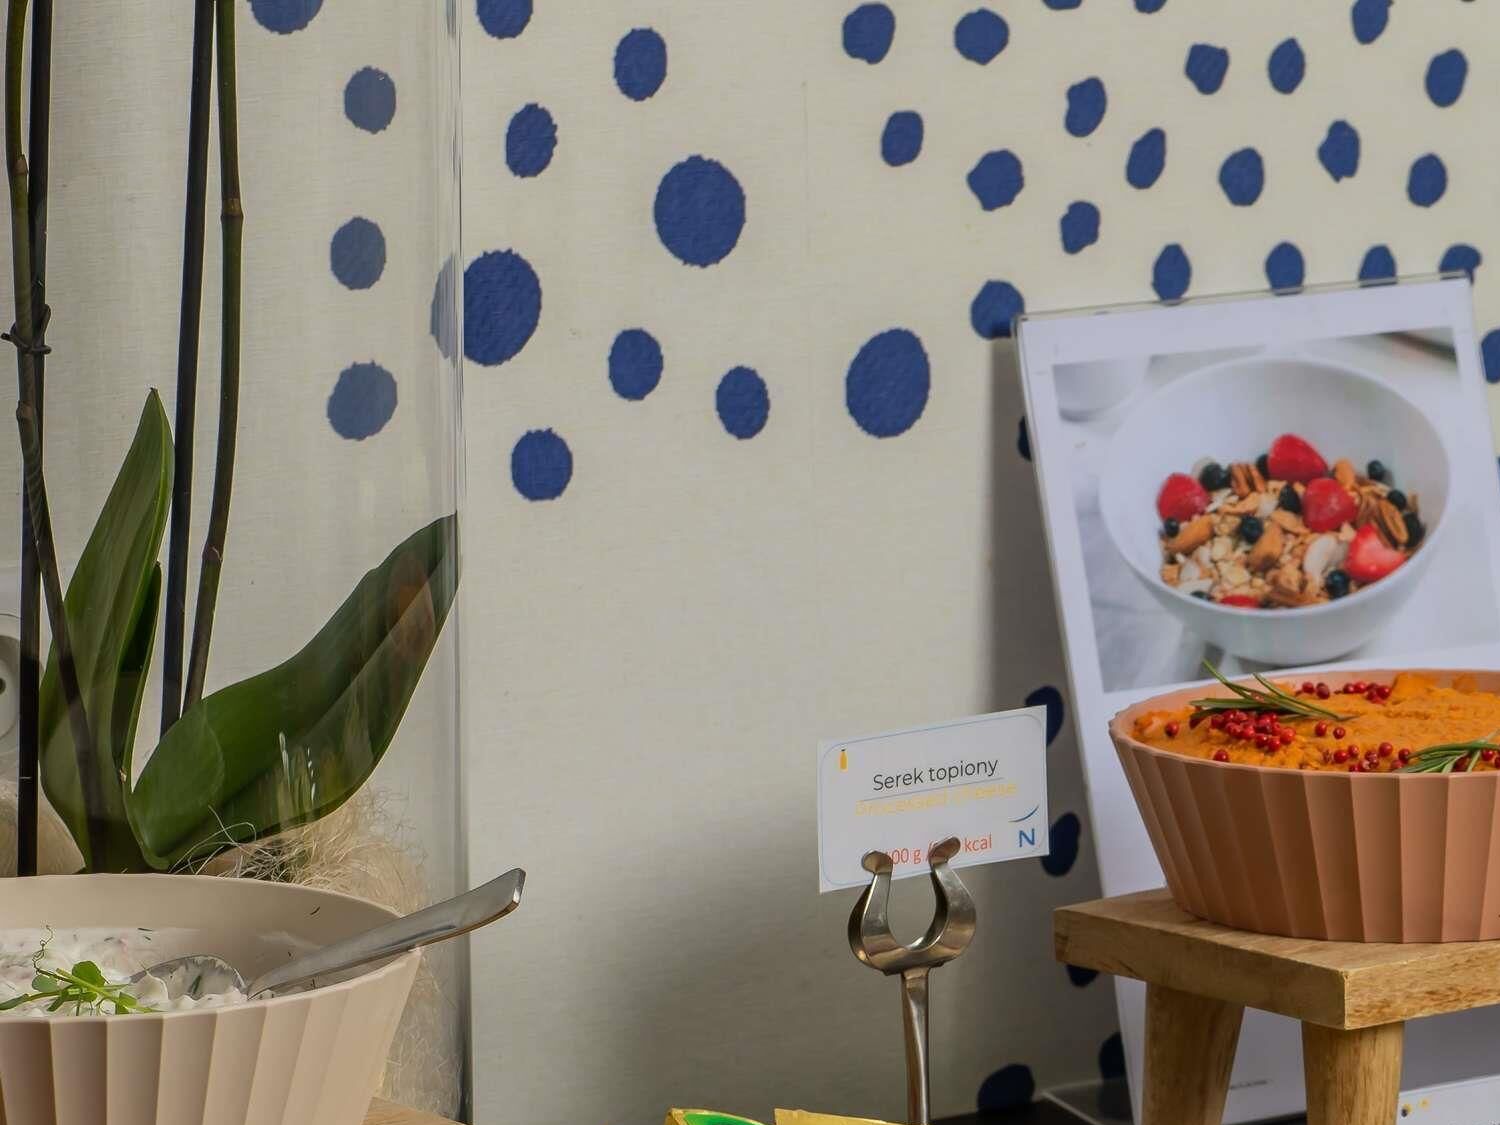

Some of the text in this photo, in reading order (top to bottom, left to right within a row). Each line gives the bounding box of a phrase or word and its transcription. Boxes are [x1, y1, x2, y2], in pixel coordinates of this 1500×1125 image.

[872, 758, 999, 792] Serek topiony
[913, 849, 922, 865] g
[965, 832, 992, 852] kcal
[1018, 827, 1036, 848] N
